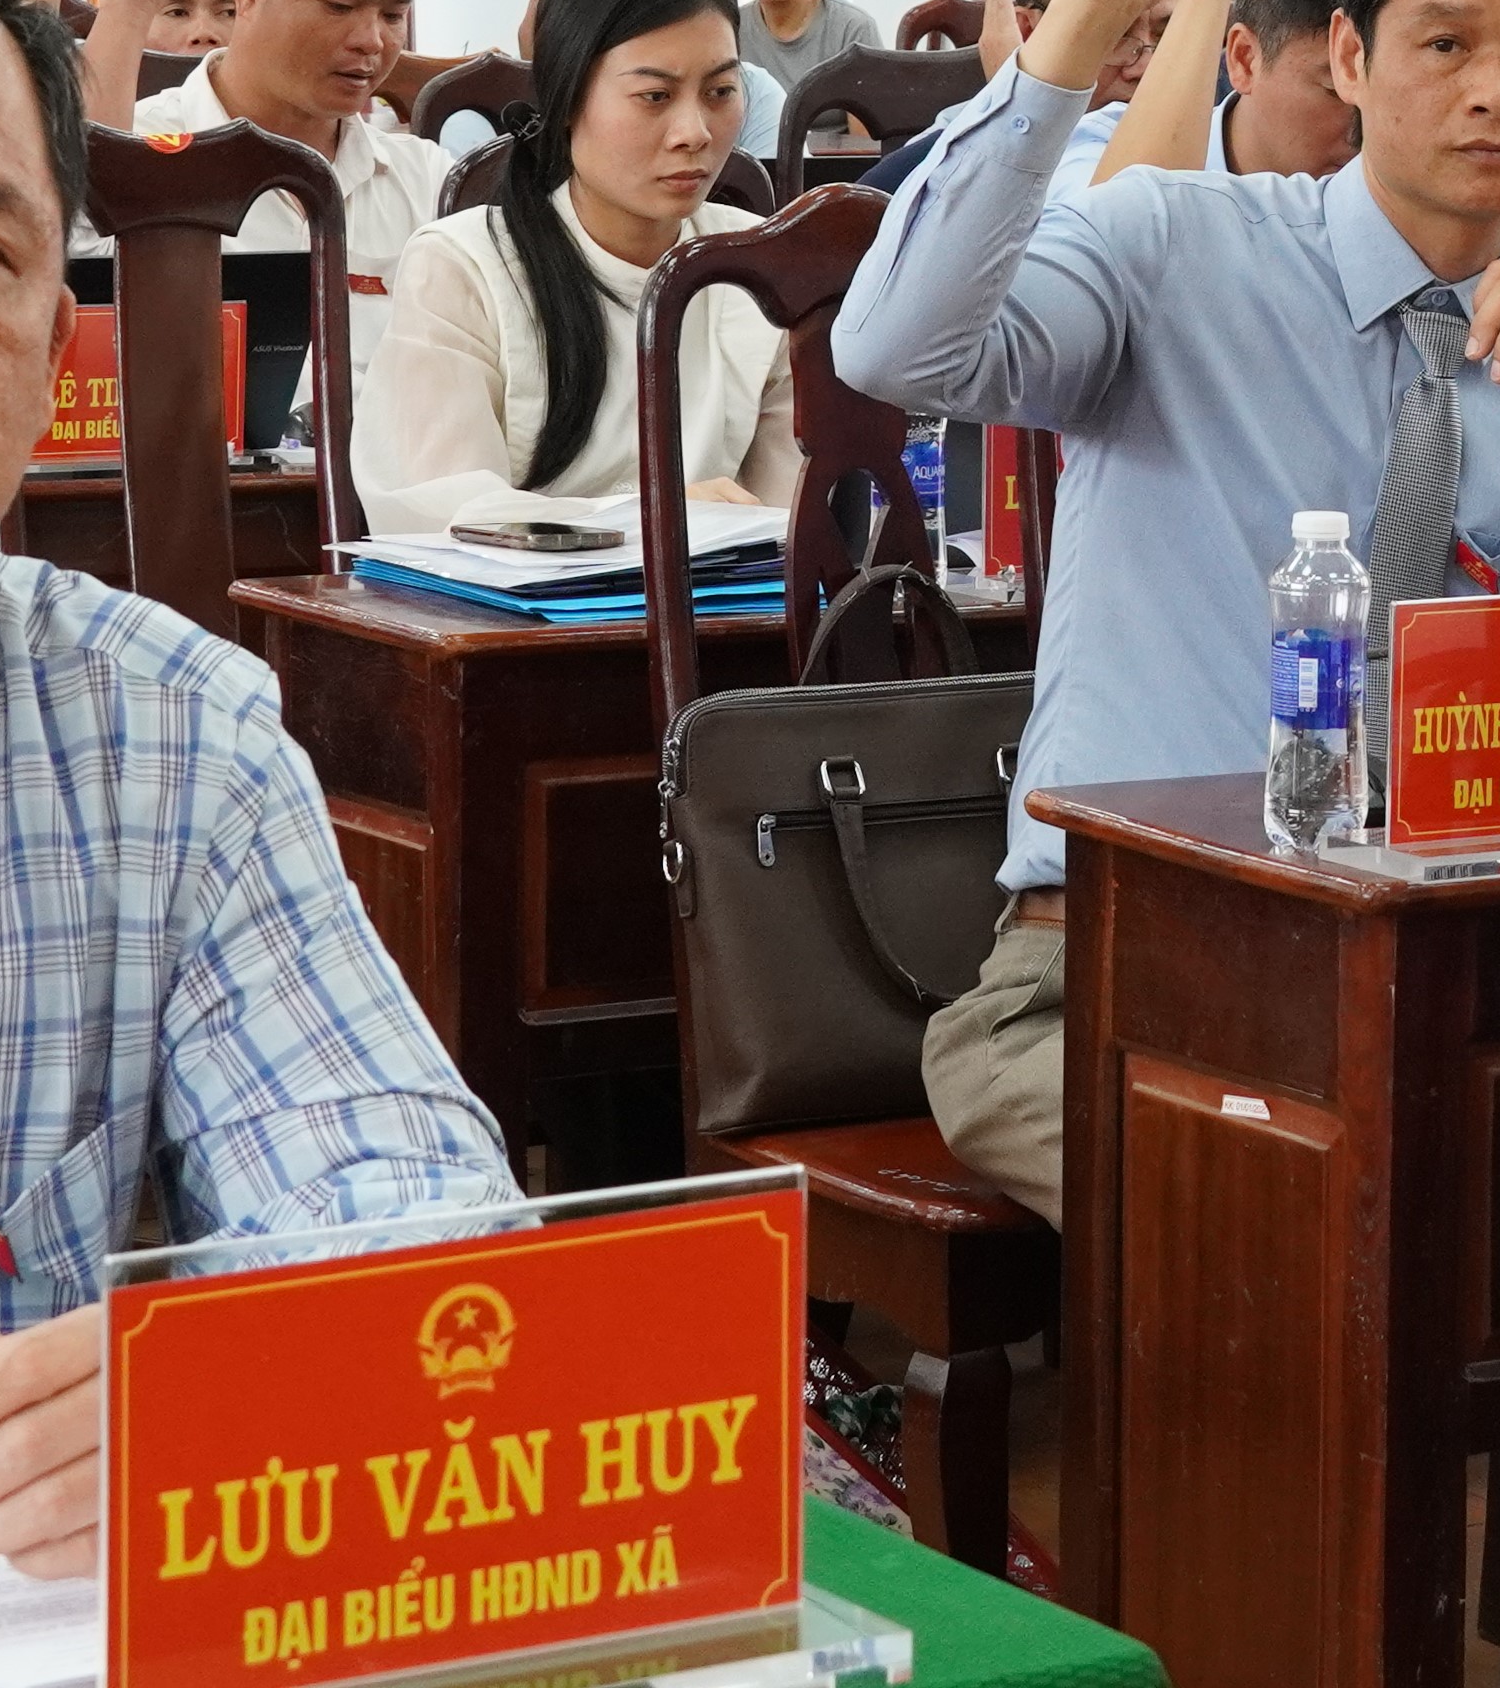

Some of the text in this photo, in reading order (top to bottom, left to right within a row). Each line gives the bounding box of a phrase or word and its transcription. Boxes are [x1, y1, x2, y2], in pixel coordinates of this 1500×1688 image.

[52, 420, 80, 445] ĐẠI
[1453, 777, 1493, 814] ĐẠI
[158, 1394, 758, 1579] LƯU VĂN HUY
[243, 1524, 679, 1670] ĐẠI BIỂU HĐND XÃ
